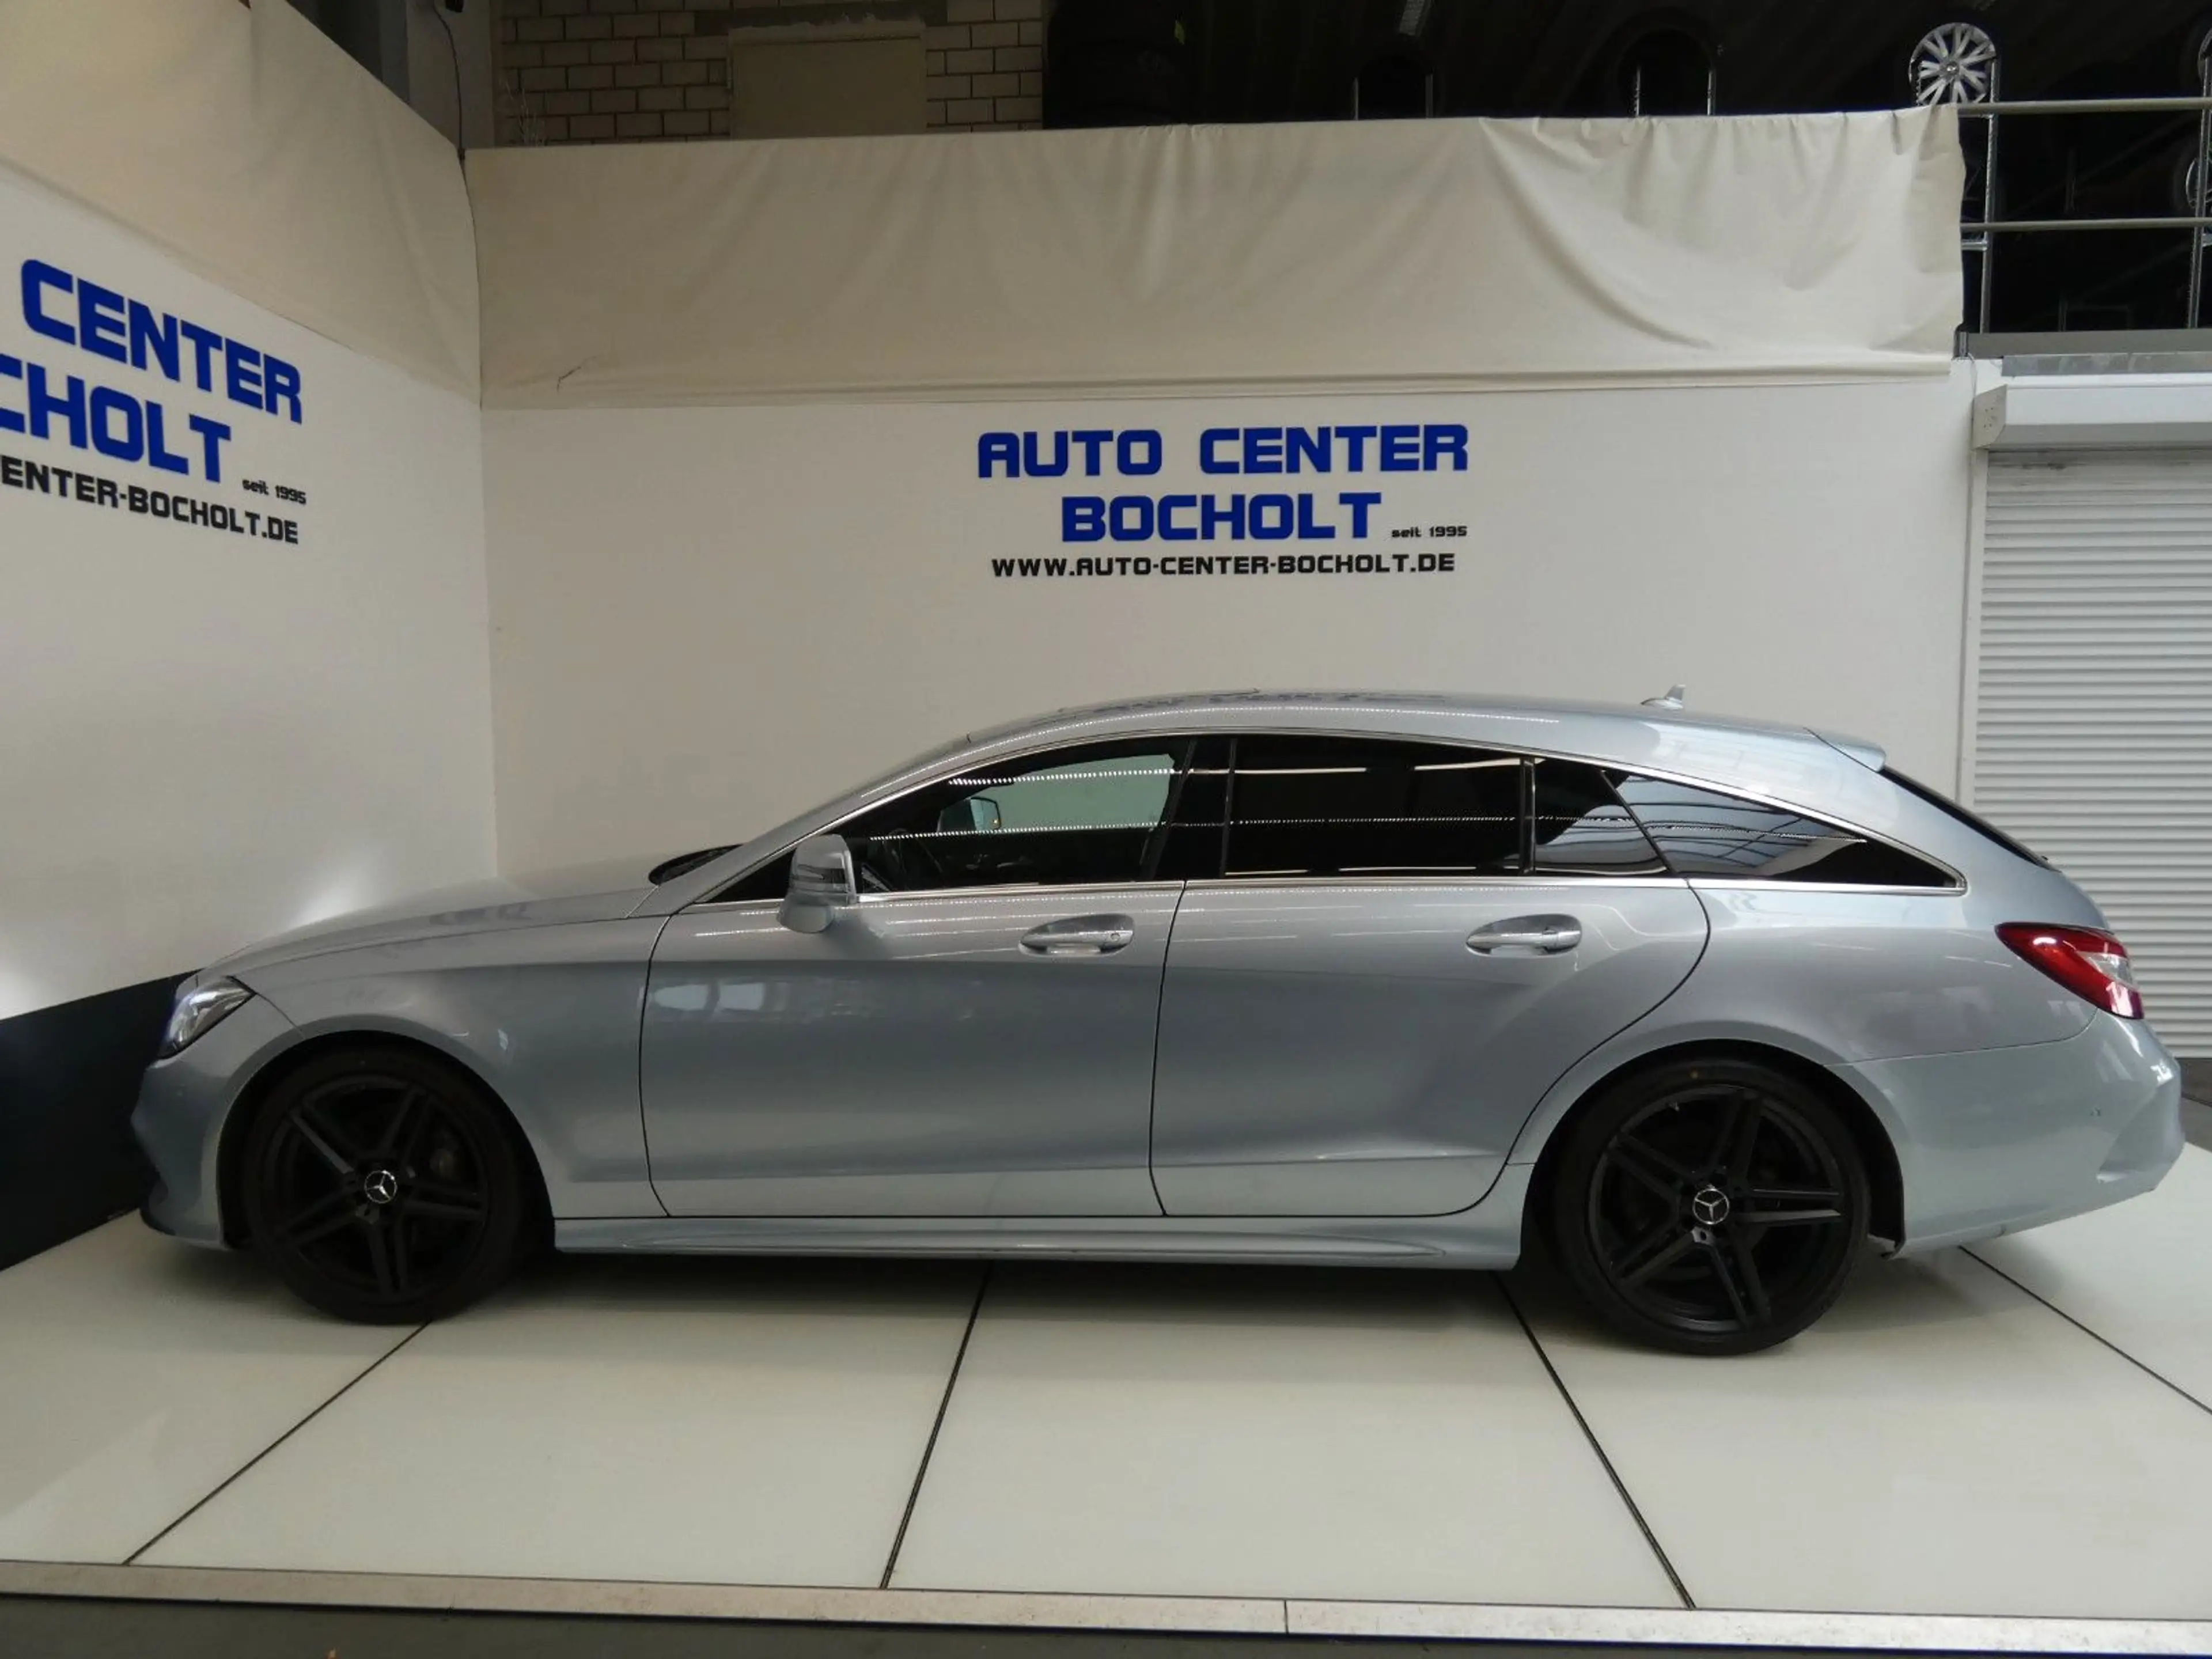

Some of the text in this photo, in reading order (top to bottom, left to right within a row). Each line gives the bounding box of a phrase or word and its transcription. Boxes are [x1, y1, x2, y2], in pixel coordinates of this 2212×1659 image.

[21, 259, 302, 425] CENTER
[978, 424, 1469, 479] AUTO CENTER
[1, 454, 298, 545] ENTER-BOCHOLT.DE
[242, 479, 269, 495] seit
[275, 485, 307, 505] 1995
[1061, 492, 1468, 543] BOCHOLT seit 1995
[991, 552, 1455, 578] WWW.AUTO-CENTER-BOCHOLT.DE
